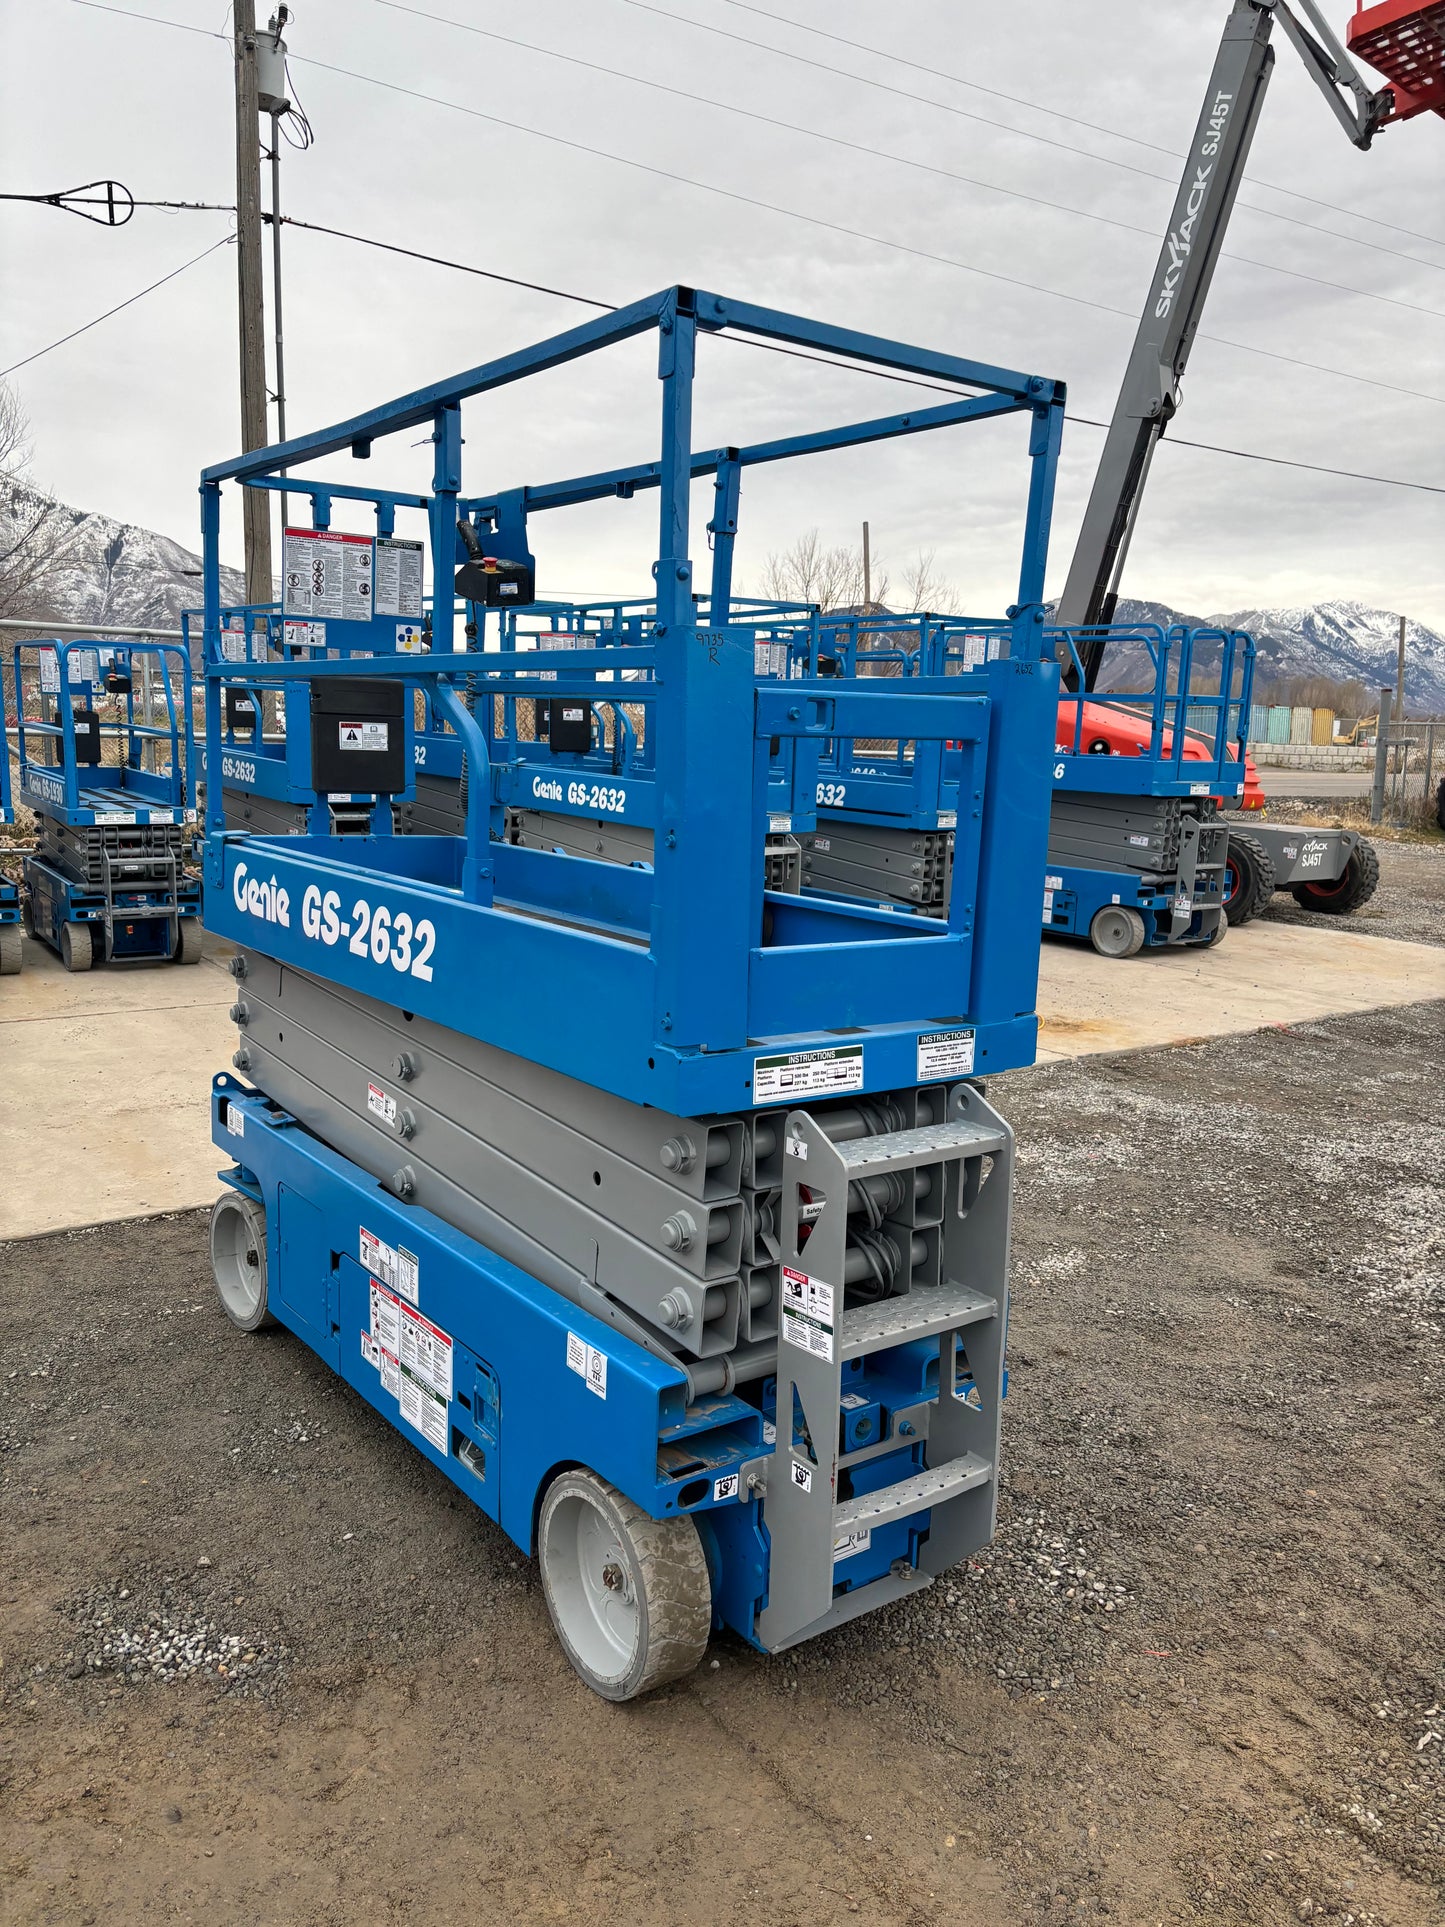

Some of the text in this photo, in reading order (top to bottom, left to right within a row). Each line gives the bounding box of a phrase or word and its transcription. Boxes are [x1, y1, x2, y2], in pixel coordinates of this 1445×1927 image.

[1155, 90, 1233, 319] SKYJACK SJ45T
[383, 540, 417, 550] INSTRUCTIONS
[696, 632, 724, 646] 9735
[709, 647, 720, 666] R
[222, 756, 256, 784] GS-2632
[532, 776, 626, 814] Genie GS-2632
[233, 862, 436, 983] Genie GS-2632
[921, 1030, 972, 1044] INSTRUCTIONS
[788, 1050, 836, 1064] INSTRUCTIONS
[790, 1271, 806, 1283] DANGER
